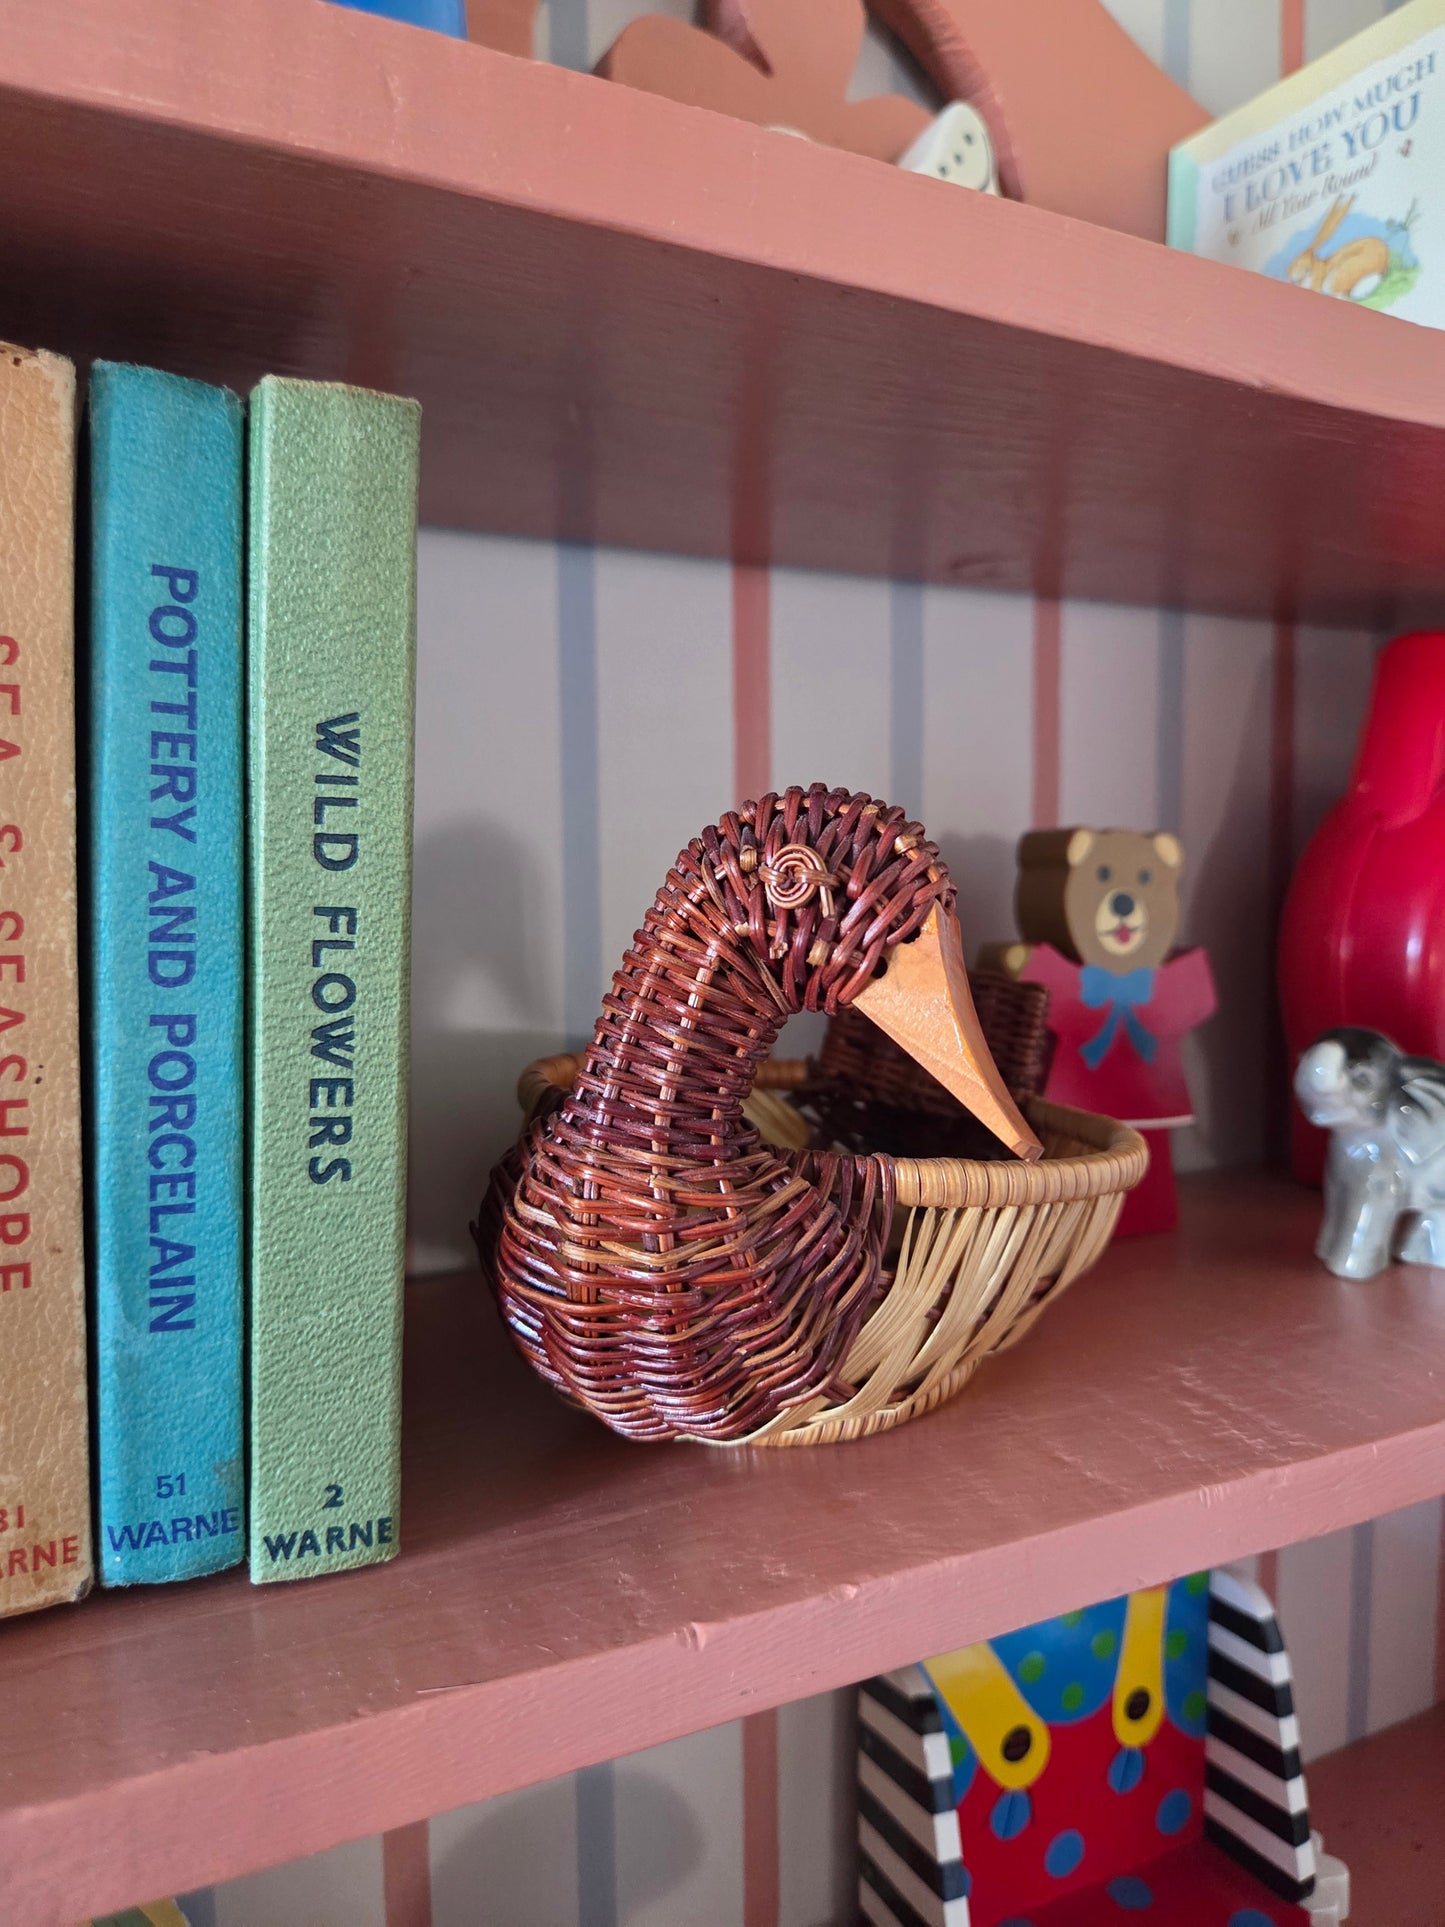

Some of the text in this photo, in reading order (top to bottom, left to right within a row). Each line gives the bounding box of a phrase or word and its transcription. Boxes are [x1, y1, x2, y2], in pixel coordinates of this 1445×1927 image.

[1289, 106, 1343, 150] HOW
[1353, 51, 1436, 112] MUCH
[1223, 90, 1422, 224] I LOVE YOU
[147, 563, 200, 1334] POTTERY AND PORCELAIN
[307, 711, 361, 1186] WILD FLOWERS
[156, 1472, 187, 1500] 51
[322, 1483, 345, 1510] 2
[107, 1506, 241, 1551] WARNE
[262, 1516, 394, 1562] WARNE
[0, 1535, 79, 1579] RNE
